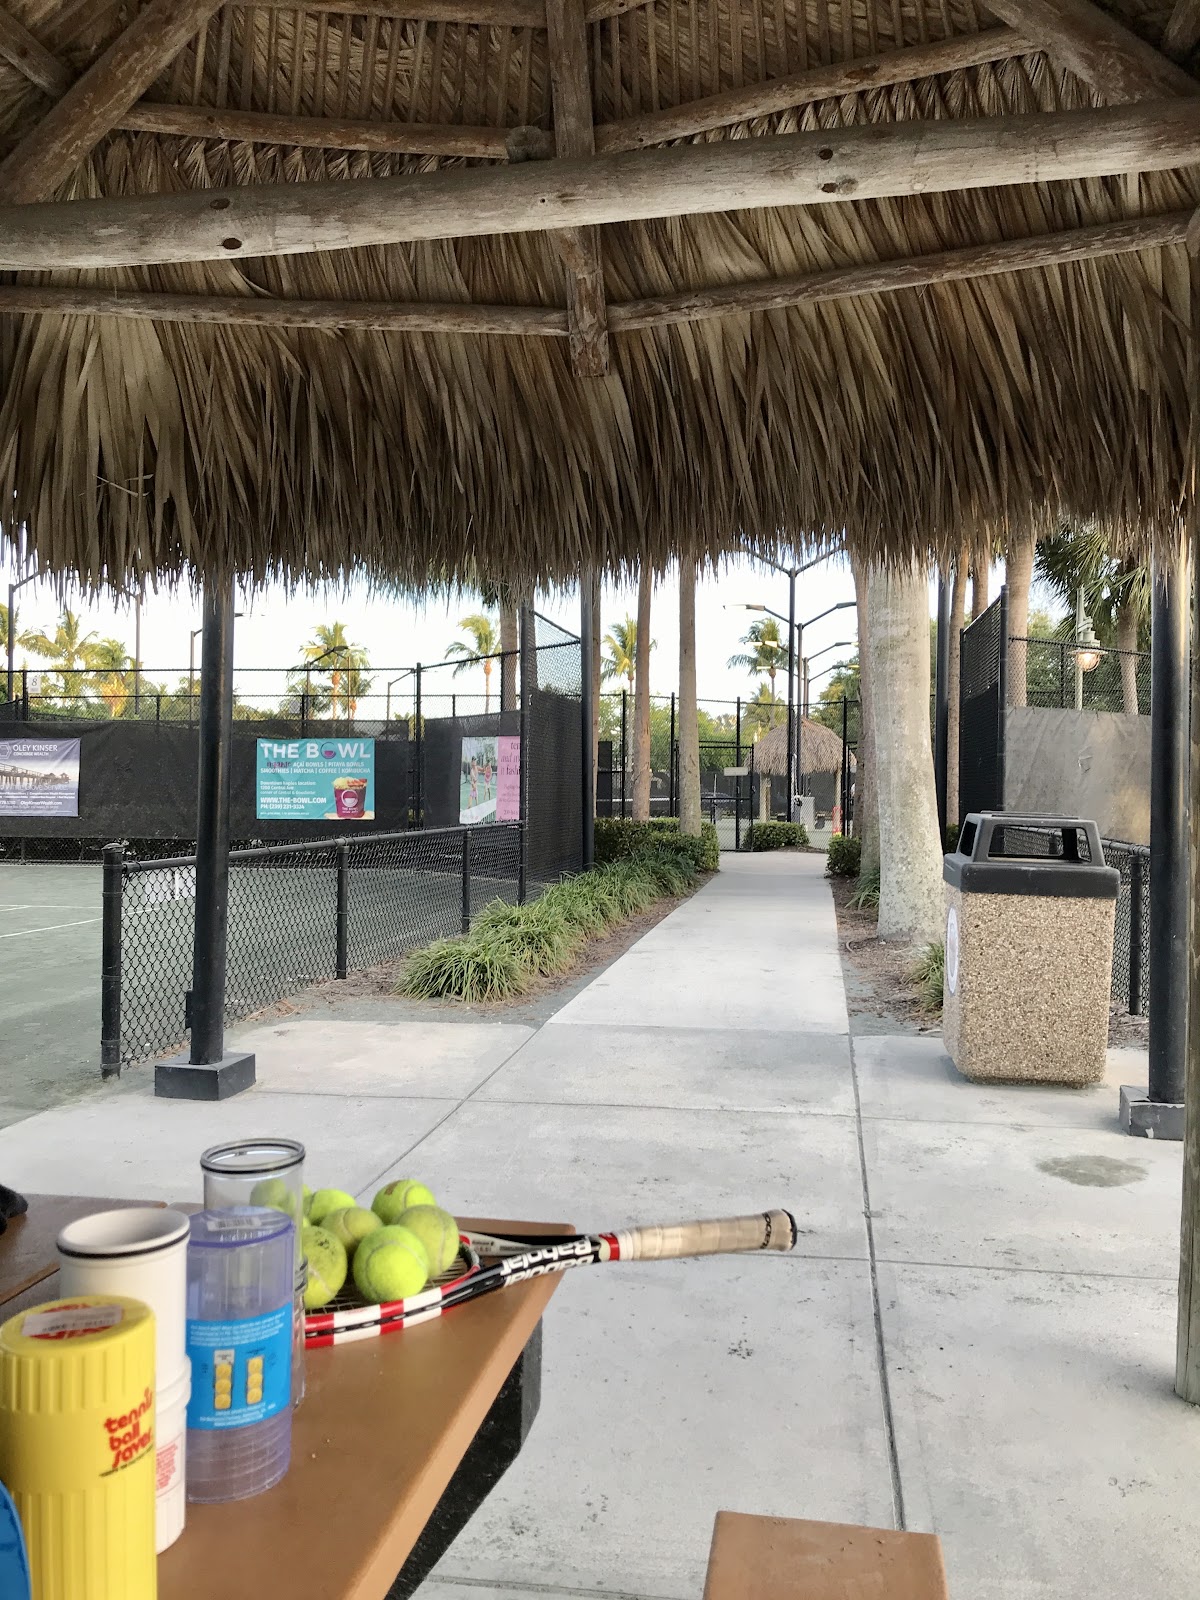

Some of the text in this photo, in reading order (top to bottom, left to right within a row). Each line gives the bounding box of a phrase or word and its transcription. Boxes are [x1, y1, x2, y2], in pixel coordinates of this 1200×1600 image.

[31, 677, 38, 687] 8
[13, 744, 58, 752] OLEY KINSER
[260, 742, 371, 759] THE BOWL
[500, 1236, 592, 1277] Babolat
[109, 1420, 140, 1451] ball
